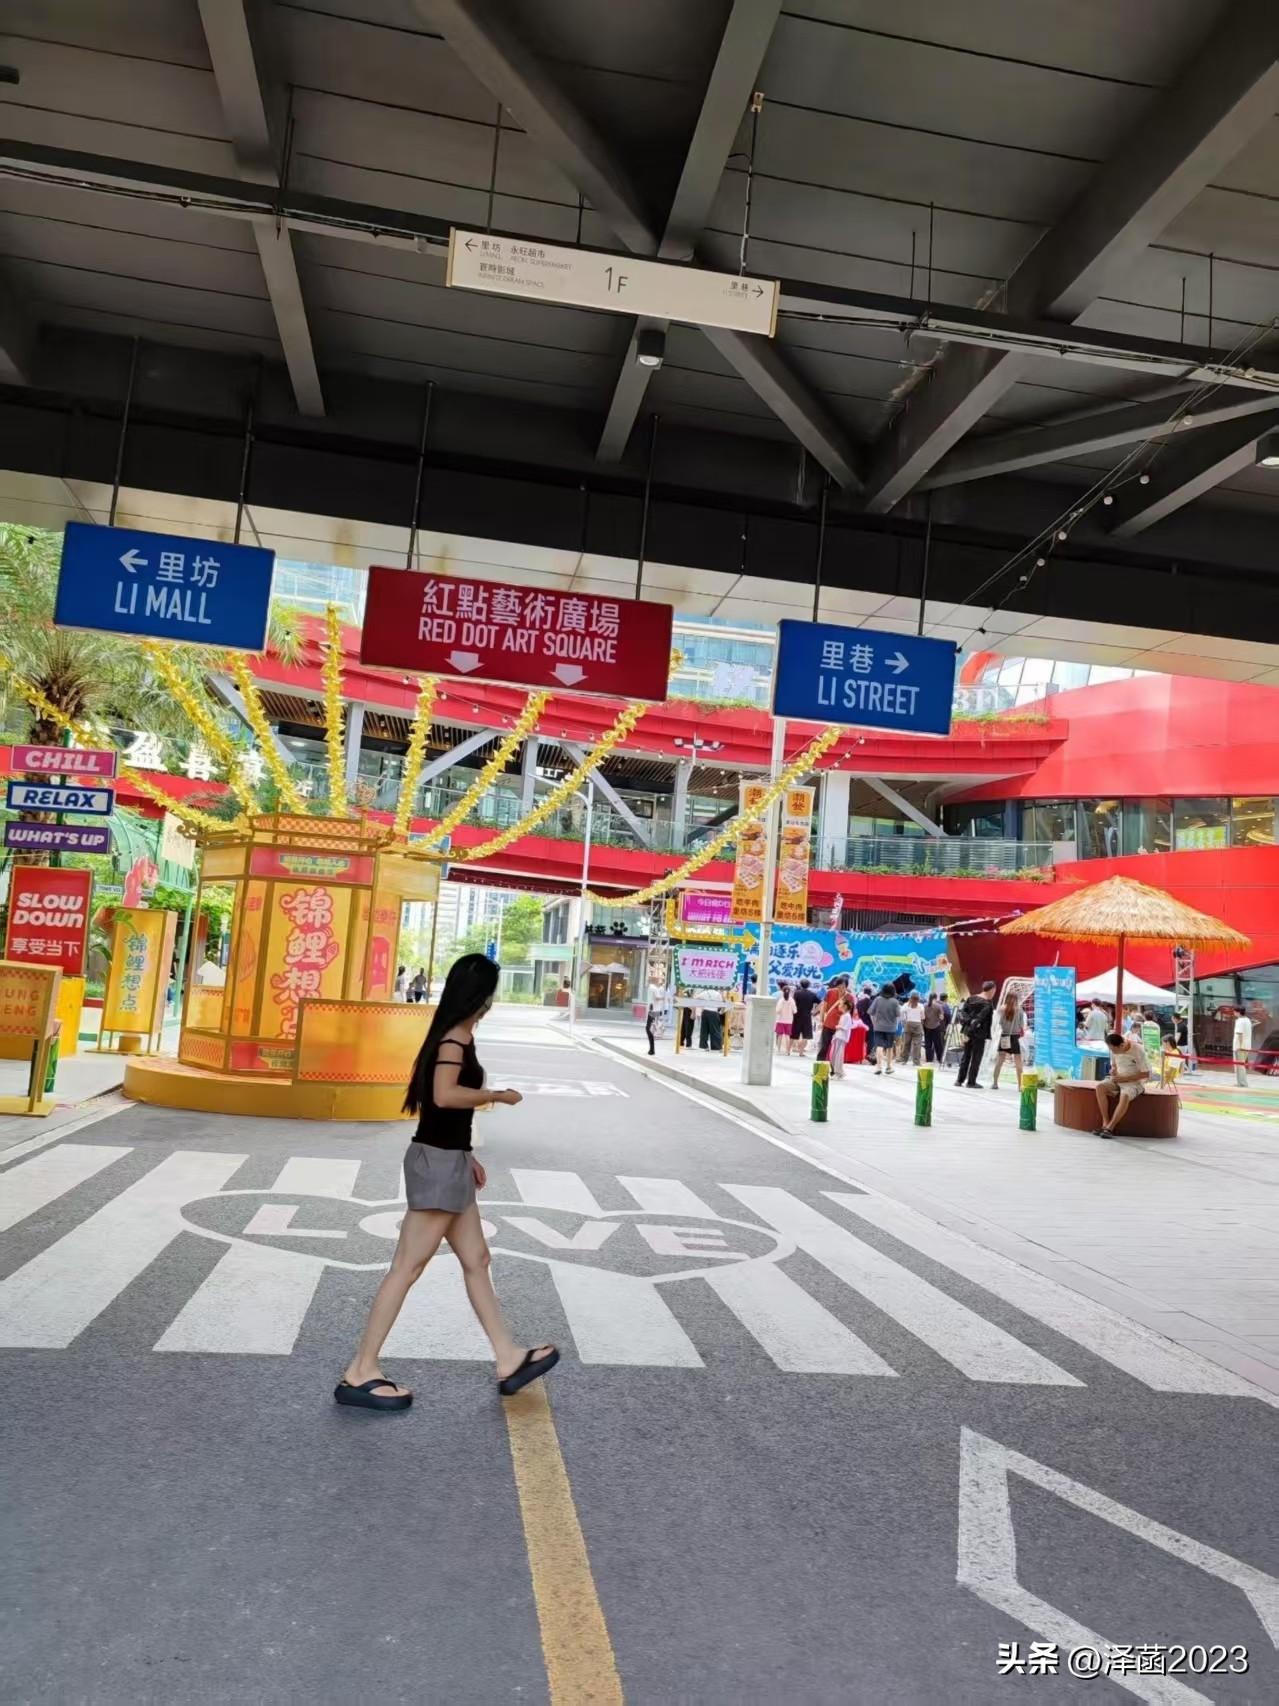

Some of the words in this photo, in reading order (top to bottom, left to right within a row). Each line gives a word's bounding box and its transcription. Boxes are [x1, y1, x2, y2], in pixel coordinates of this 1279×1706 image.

[156, 551, 221, 588] 里坊
[114, 581, 138, 614] LI
[145, 585, 212, 624] MALL
[421, 579, 621, 638] 紅點藝術廣場
[418, 617, 457, 644] RED
[462, 623, 499, 648] DOT
[502, 629, 539, 653] ART
[543, 632, 618, 664] SQUARE
[820, 640, 874, 674] 里巷
[817, 675, 837, 705] LI
[843, 679, 920, 715] STREET
[25, 750, 100, 772] CHILL
[23, 789, 96, 808] RELAX
[8, 828, 79, 845] WHAT'S
[81, 833, 105, 846] UP
[17, 892, 83, 911] SLOW
[11, 937, 80, 958] 享受当下
[119, 932, 148, 1012] 锦鲤想点
